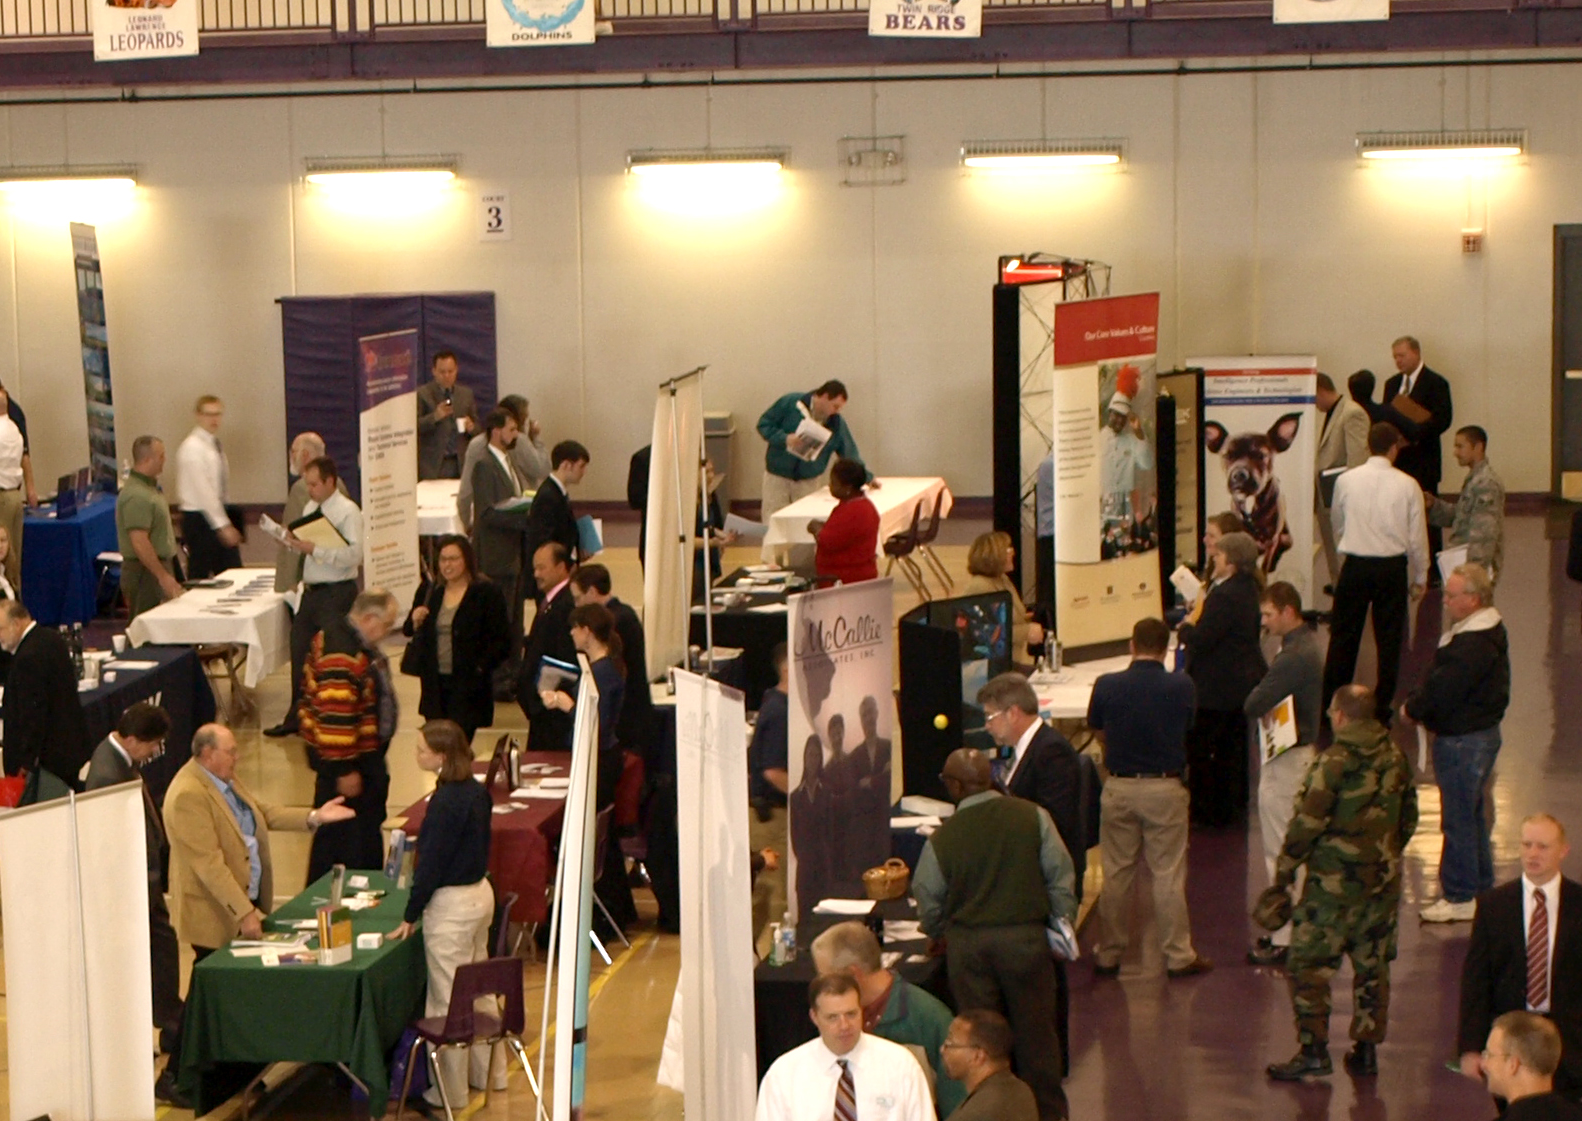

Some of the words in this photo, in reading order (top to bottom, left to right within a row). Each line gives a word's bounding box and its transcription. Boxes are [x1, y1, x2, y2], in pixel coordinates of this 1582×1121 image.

[885, 13, 966, 31] BEARS
[110, 30, 184, 52] LEOPARDS
[511, 31, 573, 41] DOLPHINS
[488, 206, 502, 229] 3
[794, 614, 881, 657] McCallie
